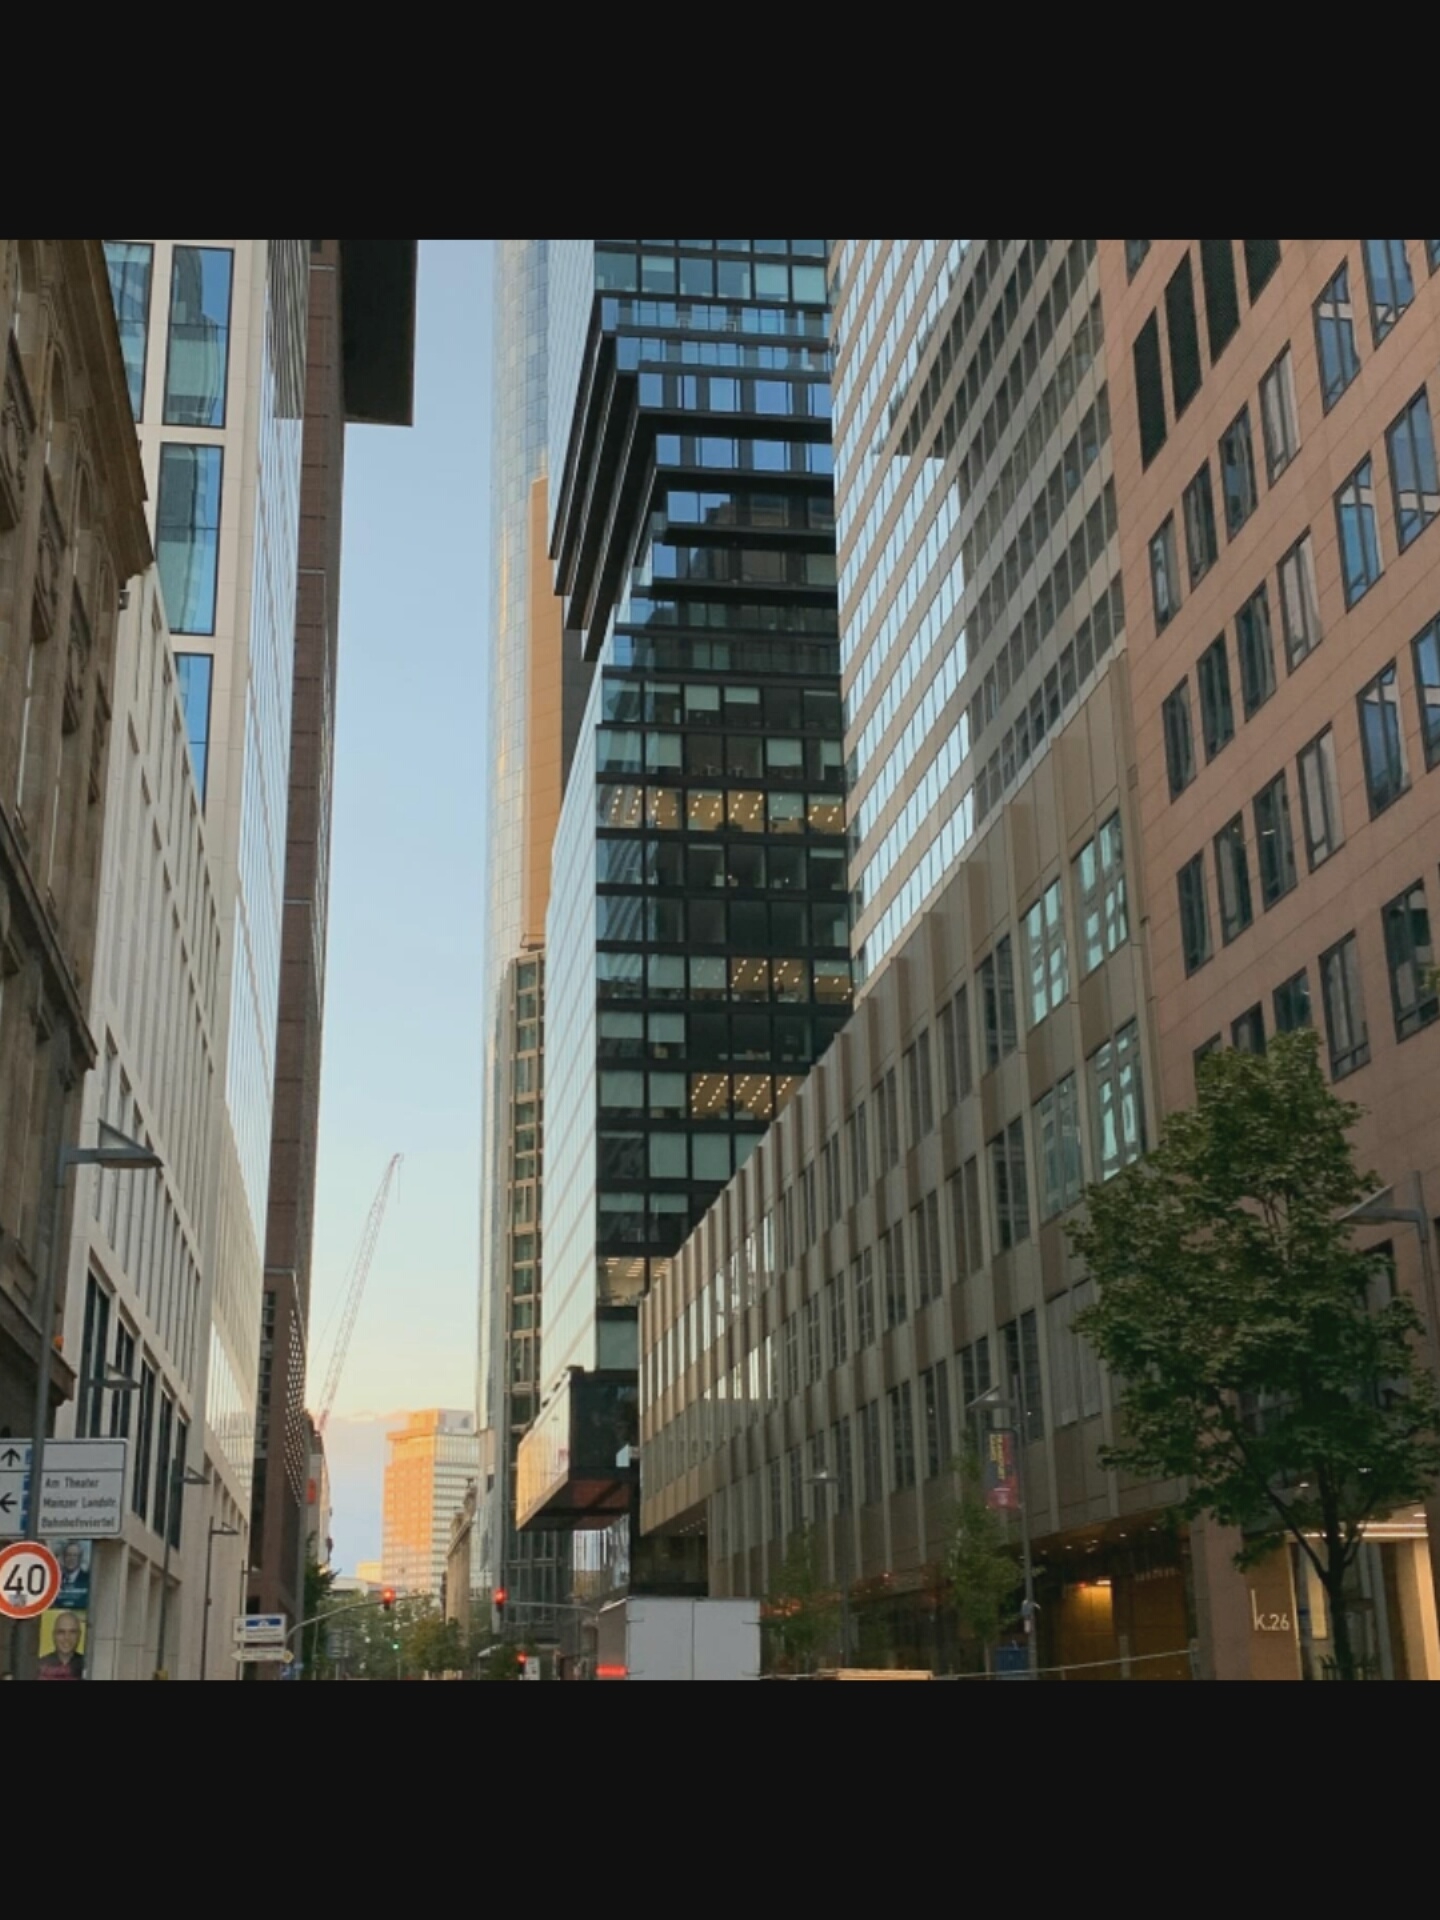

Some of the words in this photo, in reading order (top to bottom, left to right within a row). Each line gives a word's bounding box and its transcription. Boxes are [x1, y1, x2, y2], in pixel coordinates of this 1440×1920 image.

[45, 1478, 60, 1489] Am
[64, 1476, 100, 1489] Theater
[43, 1497, 78, 1509] Mainzer
[3, 1563, 46, 1597] 40
